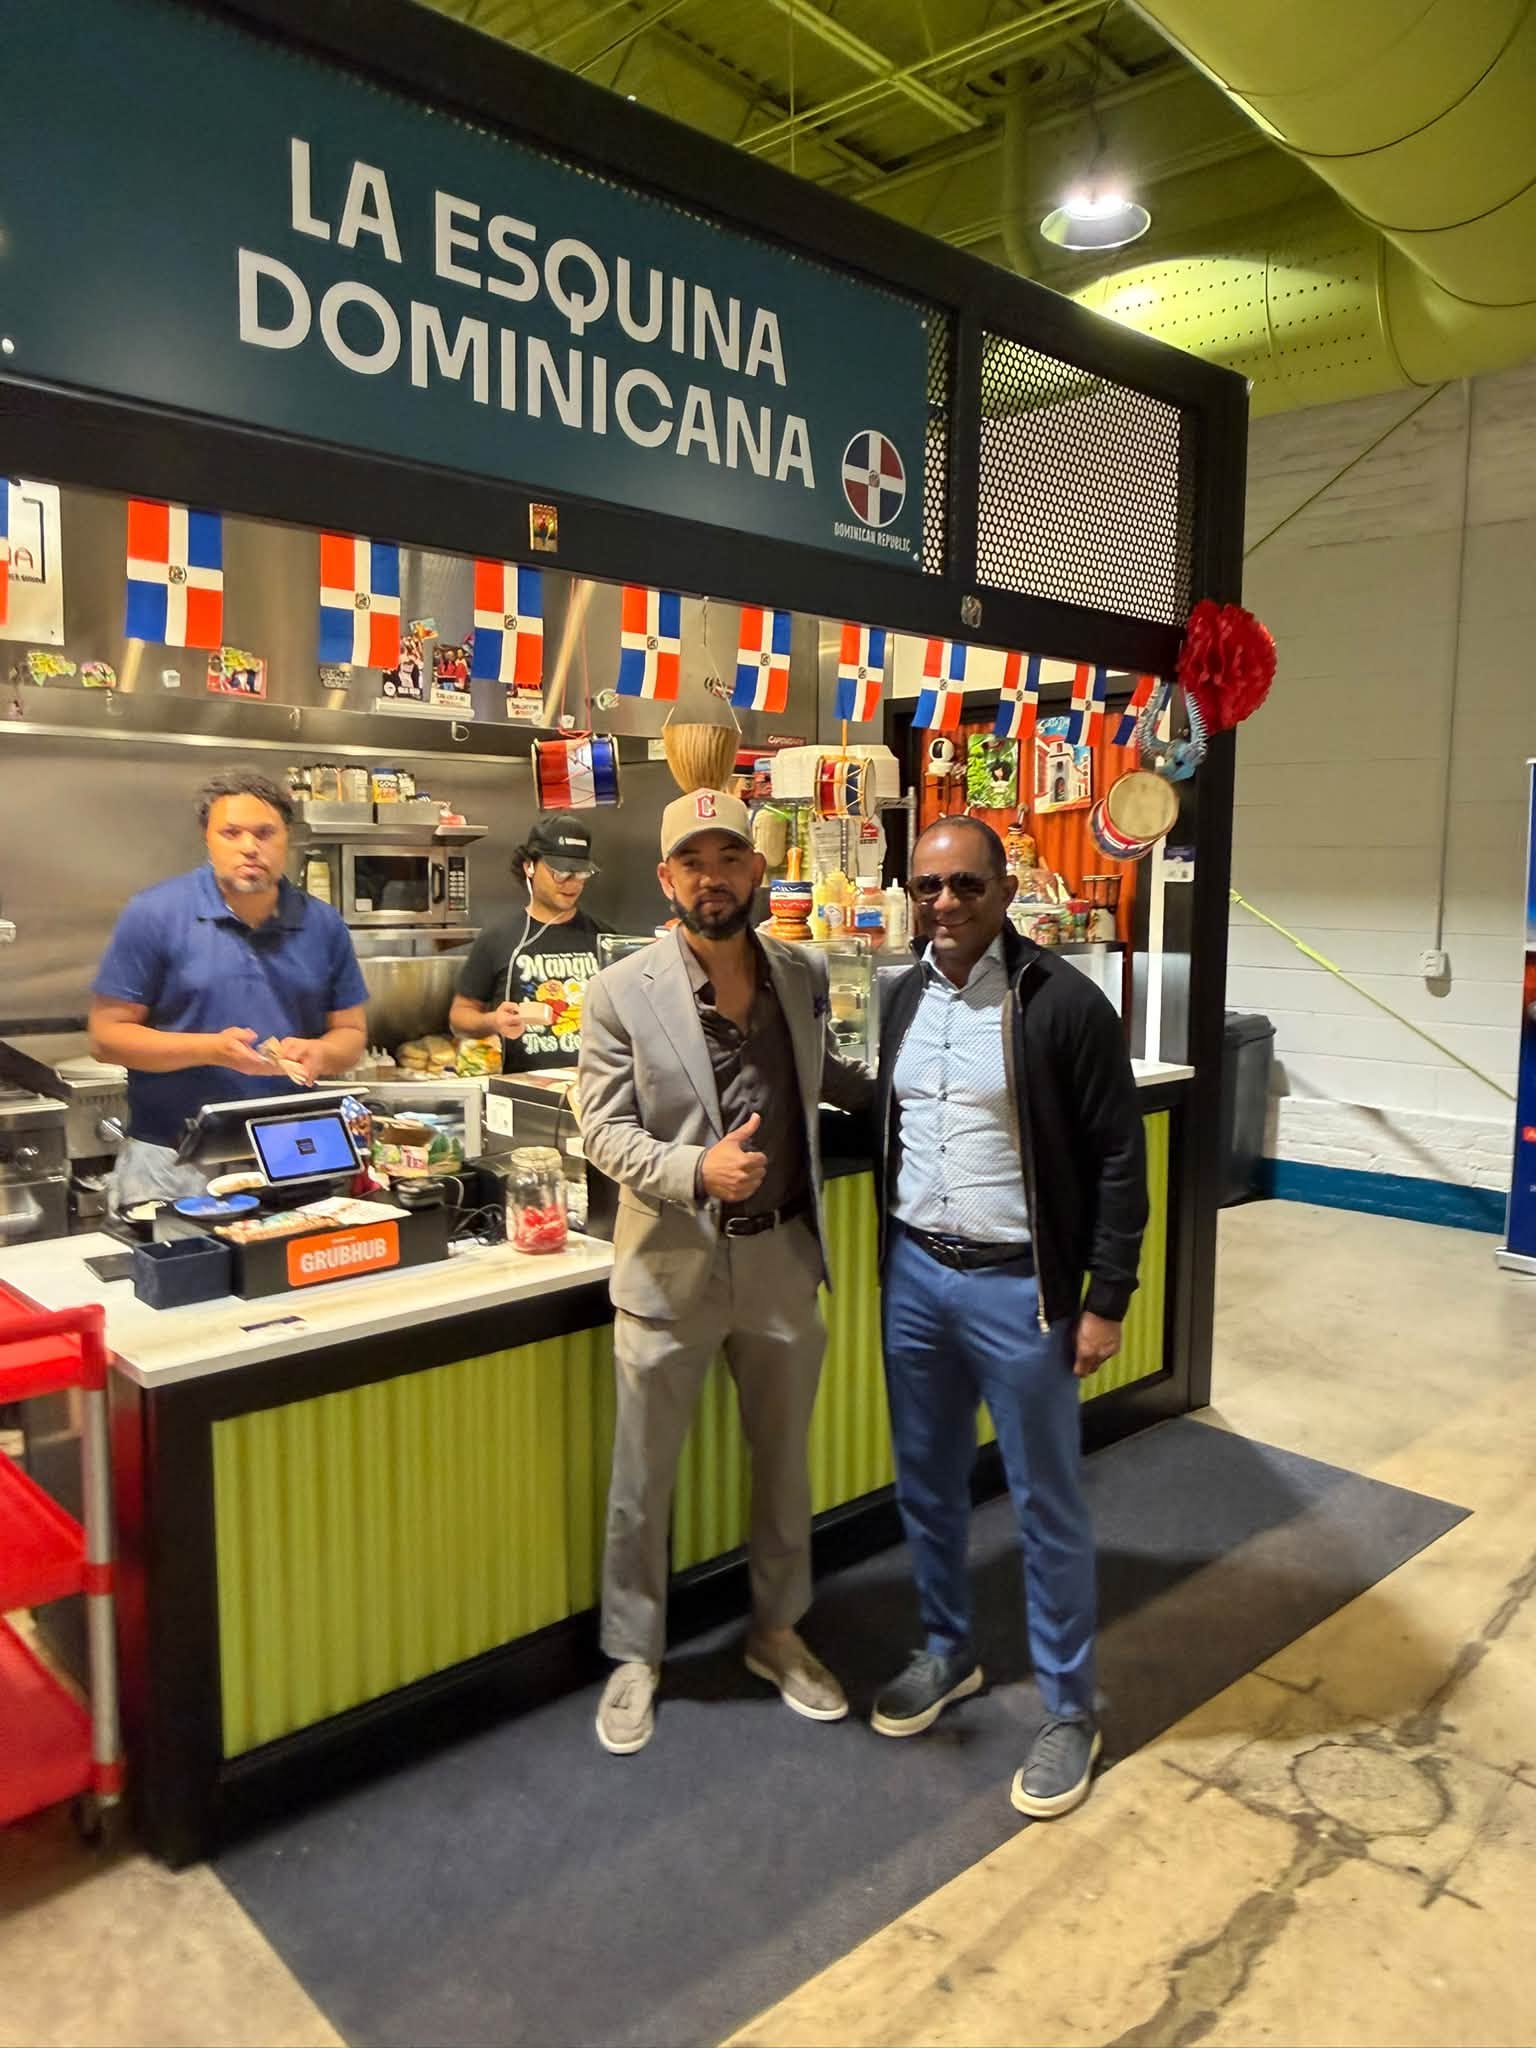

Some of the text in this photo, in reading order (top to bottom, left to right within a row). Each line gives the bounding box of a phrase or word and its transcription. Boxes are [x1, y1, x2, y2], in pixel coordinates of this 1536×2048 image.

[290, 137, 787, 386] LA ESQUINA
[238, 247, 816, 489] DOMINICANA
[834, 522, 911, 553] DOMINICAN REPUBLIC
[696, 793, 717, 820] C
[301, 1238, 386, 1272] GRUBHUB
